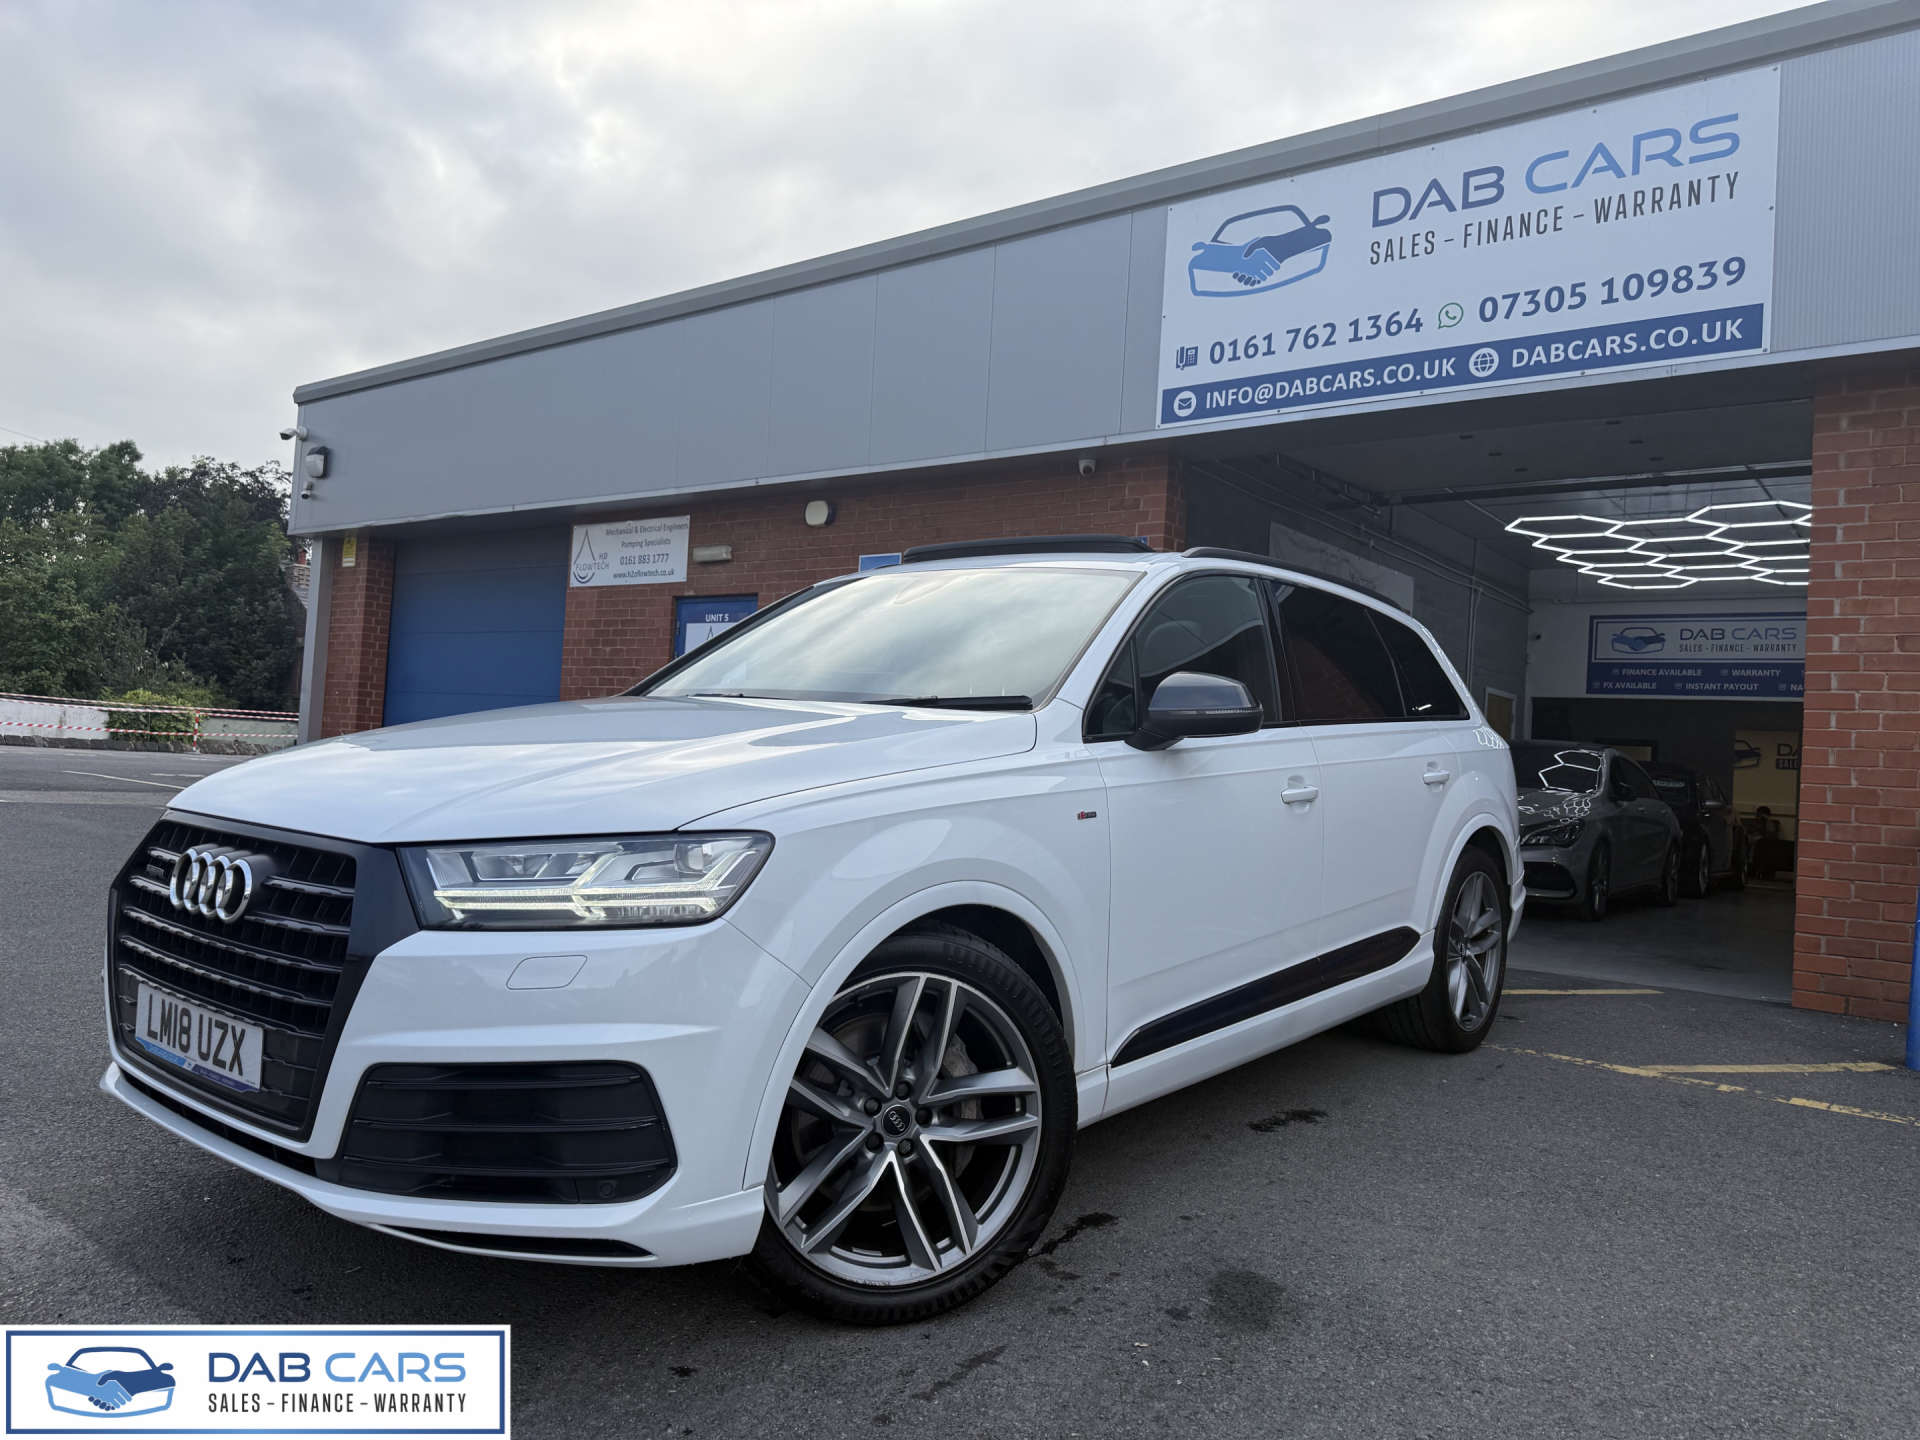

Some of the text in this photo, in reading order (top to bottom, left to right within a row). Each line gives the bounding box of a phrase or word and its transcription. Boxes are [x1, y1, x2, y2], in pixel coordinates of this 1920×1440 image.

[1371, 112, 1741, 228] DAB CARS
[1370, 230, 1436, 265] SALES
[1463, 205, 1564, 249] FINANCE
[1593, 171, 1740, 225] WARRANTY
[1478, 256, 1746, 323] 07305 109839
[1208, 307, 1424, 365] 0161 762 1364
[1511, 317, 1743, 368] DABCARS.CO.UK
[1205, 356, 1456, 409] INFO@DABCARS.CO.UK
[620, 555, 636, 566] 0161
[652, 553, 670, 564] 1777
[705, 613, 729, 622] UNIT 5
[1679, 627, 1798, 641] DAB CARS
[1621, 668, 1781, 677] FINANCE AVAILABLE WARRANTY
[1679, 643, 1704, 653] SALES
[1711, 643, 1745, 653] FINANCE
[1752, 643, 1798, 653] WARRANTY
[1614, 681, 1657, 690] AVAILABLE
[1685, 682, 1720, 691] INSTANT
[1723, 682, 1760, 691] PAYOUT
[146, 993, 192, 1054] LM18
[197, 1013, 246, 1077] UZX
